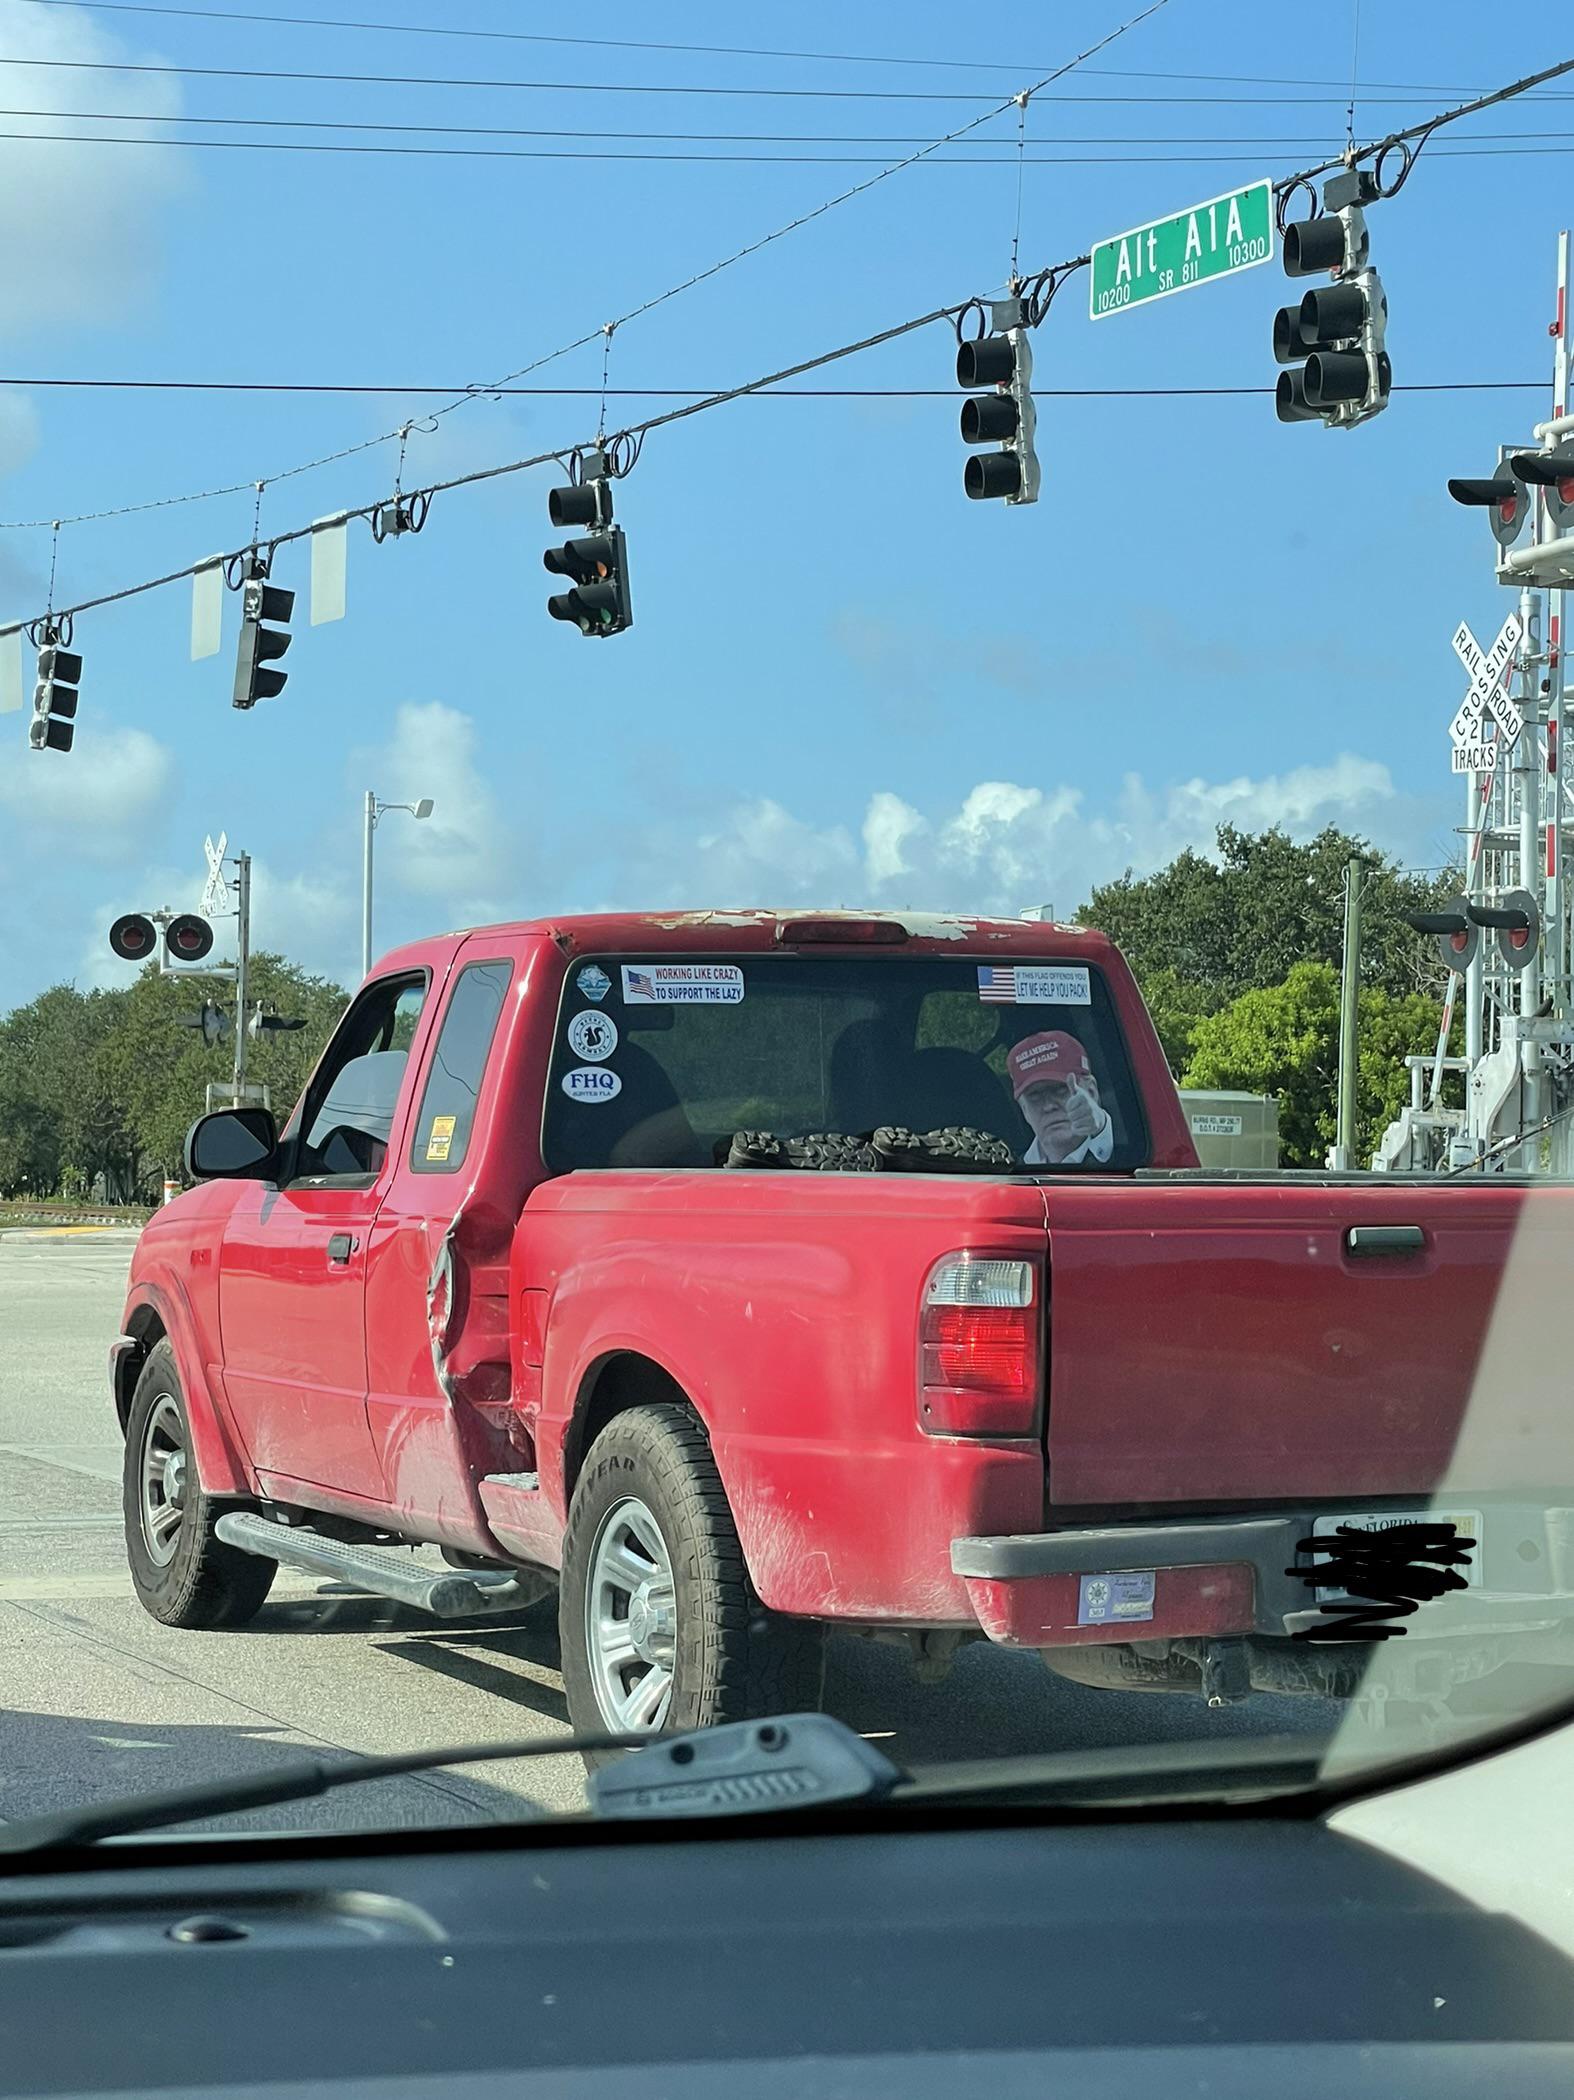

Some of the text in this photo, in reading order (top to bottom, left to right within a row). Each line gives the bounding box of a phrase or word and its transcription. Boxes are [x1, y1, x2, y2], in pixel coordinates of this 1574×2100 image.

[1116, 197, 1243, 286] Alt A1A
[1098, 236, 1265, 312] 10200 SR 811 10300
[1455, 625, 1516, 737] CROSSING
[1455, 629, 1519, 737] RAIL ROAD
[1470, 718, 1479, 740] 2
[1454, 746, 1495, 770] TRACKS
[655, 967, 739, 980] WORKING LIKE CRAZY
[655, 987, 742, 1000] TO SUPPORT THE LAZY
[1016, 982, 1028, 998] LET
[1028, 982, 1039, 998] ME
[1039, 982, 1055, 998] HELP
[1055, 983, 1069, 998] YOU
[570, 1073, 614, 1090] FHQ
